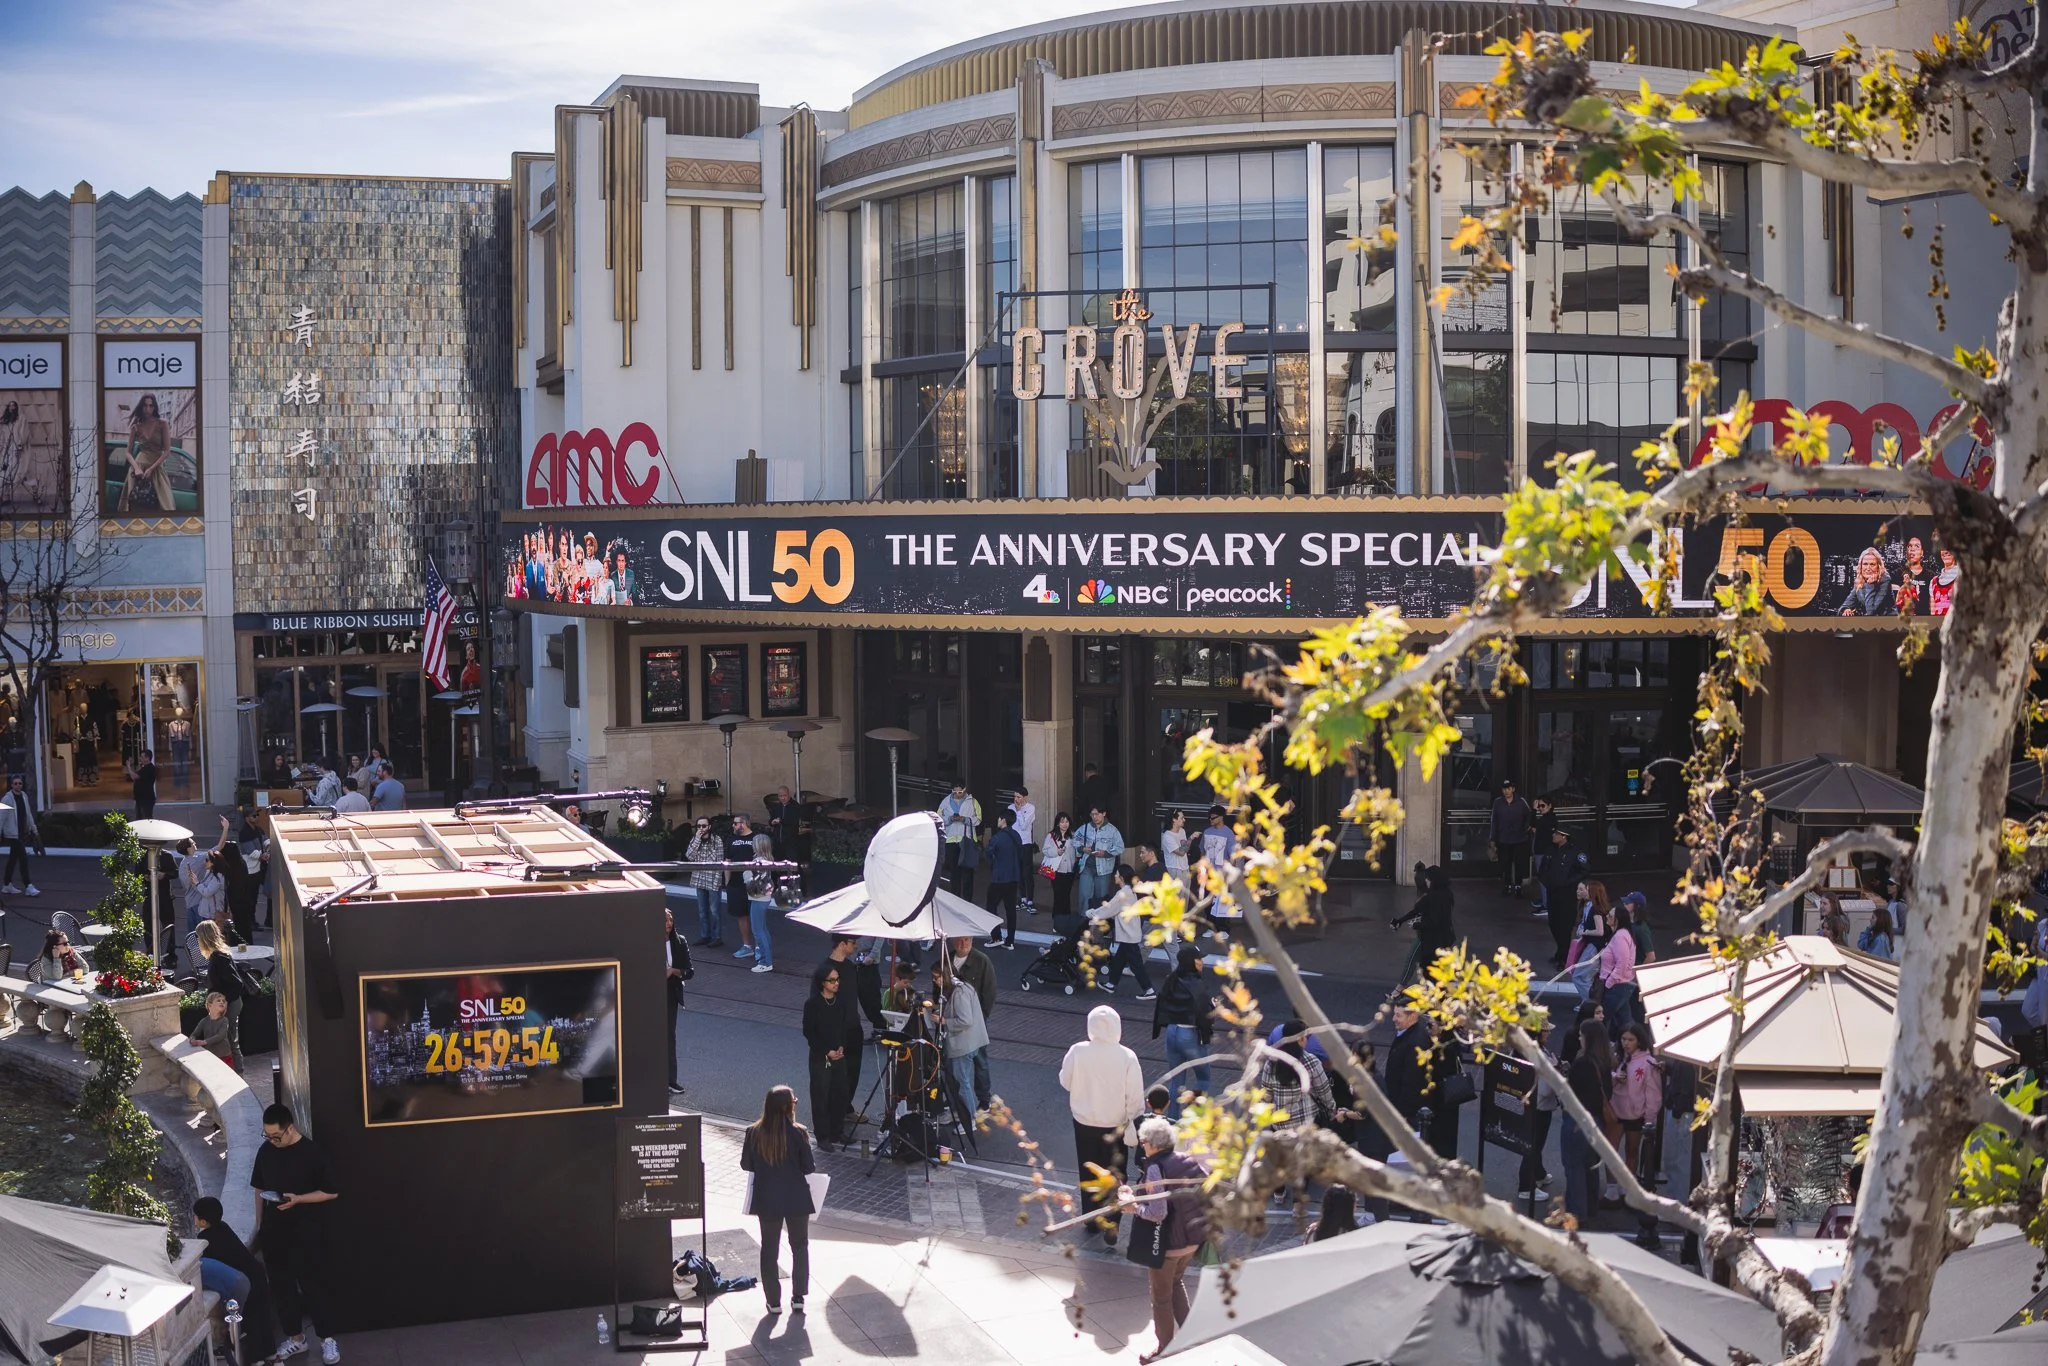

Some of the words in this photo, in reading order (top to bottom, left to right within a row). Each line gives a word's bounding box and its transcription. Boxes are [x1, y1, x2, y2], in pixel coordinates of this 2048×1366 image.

[1109, 288, 1154, 321] the
[118, 353, 183, 378] maje
[1012, 321, 1248, 400] GROVE
[885, 533, 958, 566] THE
[970, 532, 1286, 567] ANNIVERSARY
[1299, 532, 1493, 567] SPECIAL
[660, 528, 855, 605] SNL50
[1543, 527, 1820, 609] NL50
[1022, 574, 1048, 604] 4
[1117, 585, 1169, 604] NBC
[1186, 581, 1284, 612] peacock
[273, 617, 308, 630] BLUE
[314, 614, 368, 629] RIBBON
[373, 613, 414, 627] SUSHI
[62, 632, 116, 651] maje
[460, 996, 526, 1018] SNL50
[424, 1025, 560, 1073] 26:59:54
